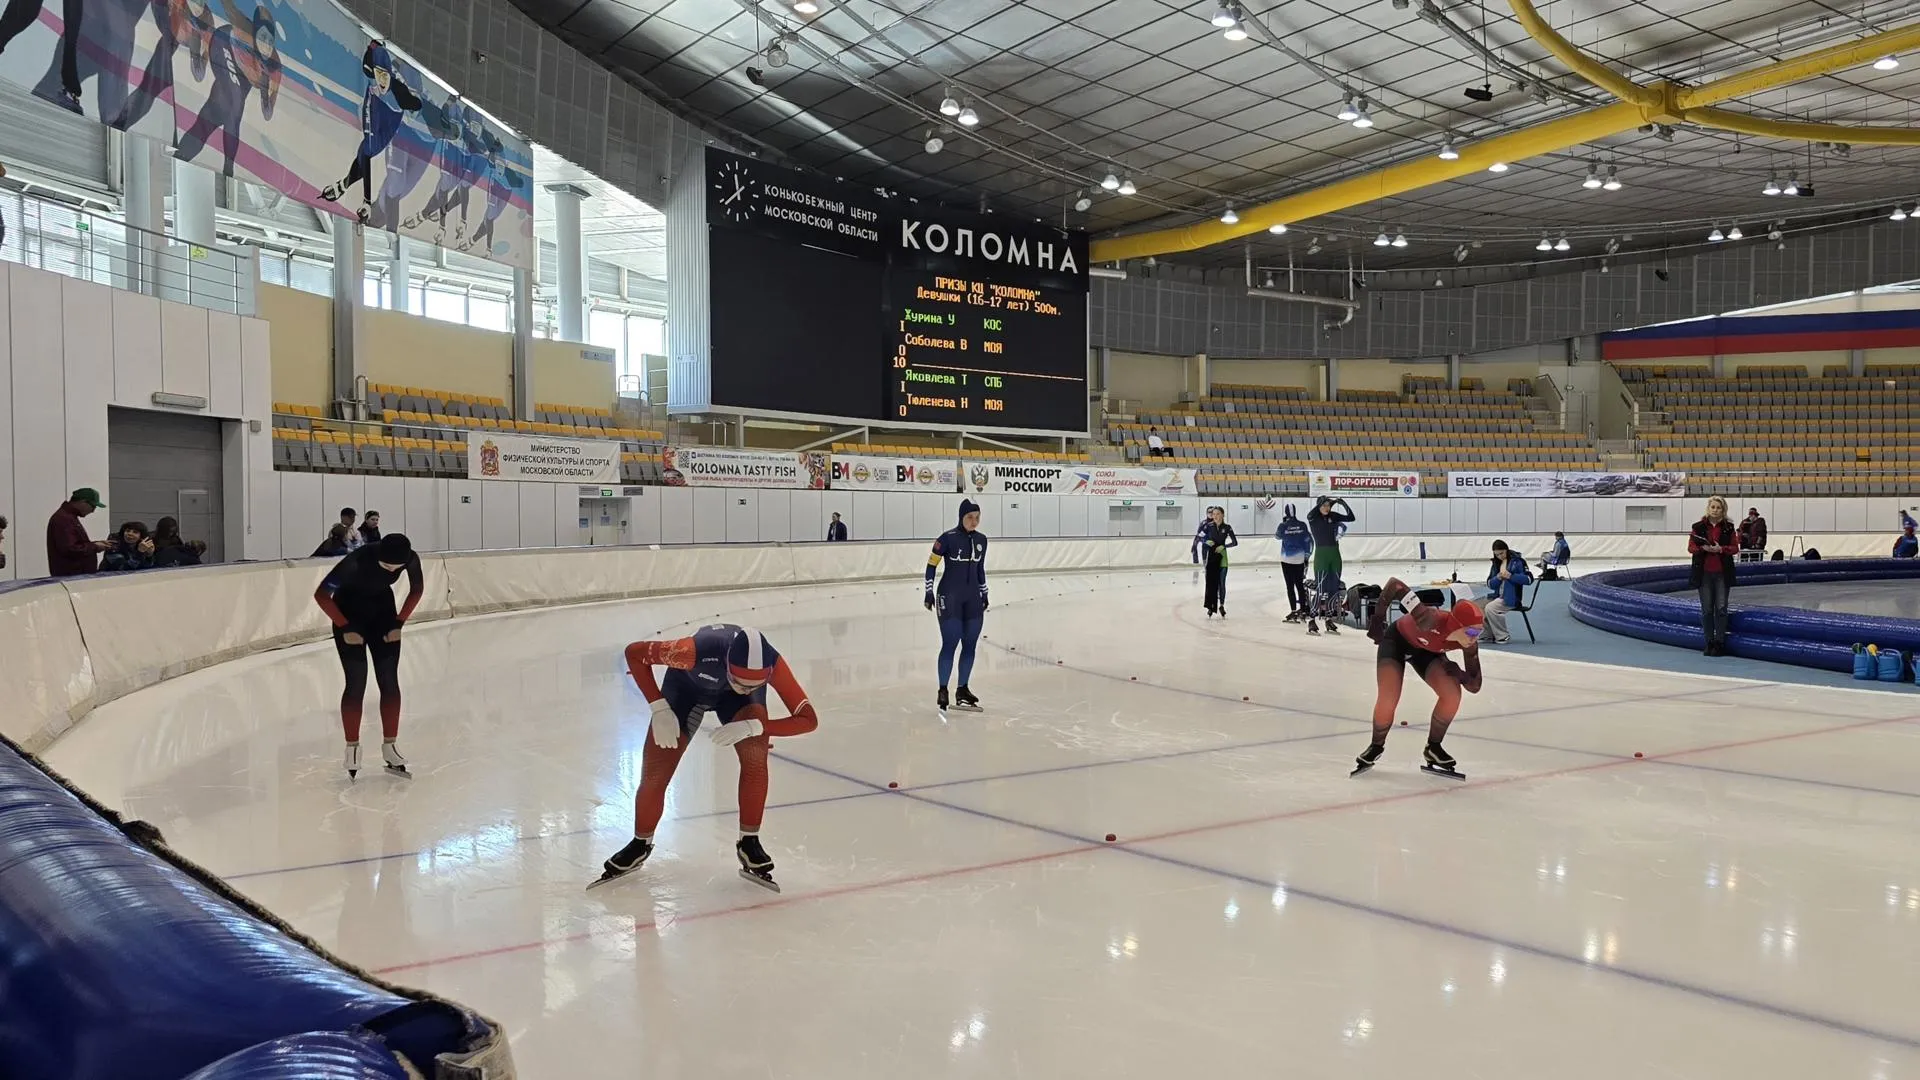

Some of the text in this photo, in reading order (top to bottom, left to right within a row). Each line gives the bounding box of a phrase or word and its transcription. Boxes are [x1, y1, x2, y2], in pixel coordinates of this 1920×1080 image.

[764, 184, 878, 222] КОНЬКОБЕЖНЫЙ ЦЕНТР
[764, 204, 878, 242] МОСКОВСКОЙ ОБЛАСТИ
[902, 219, 1079, 274] КОЛОМНА
[935, 276, 1041, 301] ПРИЗЫ КЦ "КОЛОМНА"
[917, 286, 961, 303] Девушки
[967, 293, 1001, 308] (16-17
[1006, 300, 1030, 312] лет)
[983, 318, 1002, 331] КОС
[905, 333, 1003, 354] Соболева В МОЯ
[893, 357, 906, 368] 10
[905, 369, 955, 385] Яковлева
[984, 376, 1003, 388] СПБ
[907, 393, 956, 408] Тюленева
[984, 399, 1003, 411] МОЯ
[531, 444, 581, 455] МИНИСТЕРСТВО
[503, 454, 610, 466] ФИЗИЧЕСКОЙ КУЛЬТУРЫ И СПОРТА
[521, 466, 594, 477] МОСКОВСКОЙ ОБЛАСТИ
[691, 463, 796, 477] KOLOMNA TASTY FISH
[995, 466, 1062, 479] МИНСПОРТ
[1005, 481, 1052, 493] РОССИИ
[1334, 478, 1394, 486] ЛОР-ОРГАНОВ
[1456, 477, 1509, 487] BELGEE
